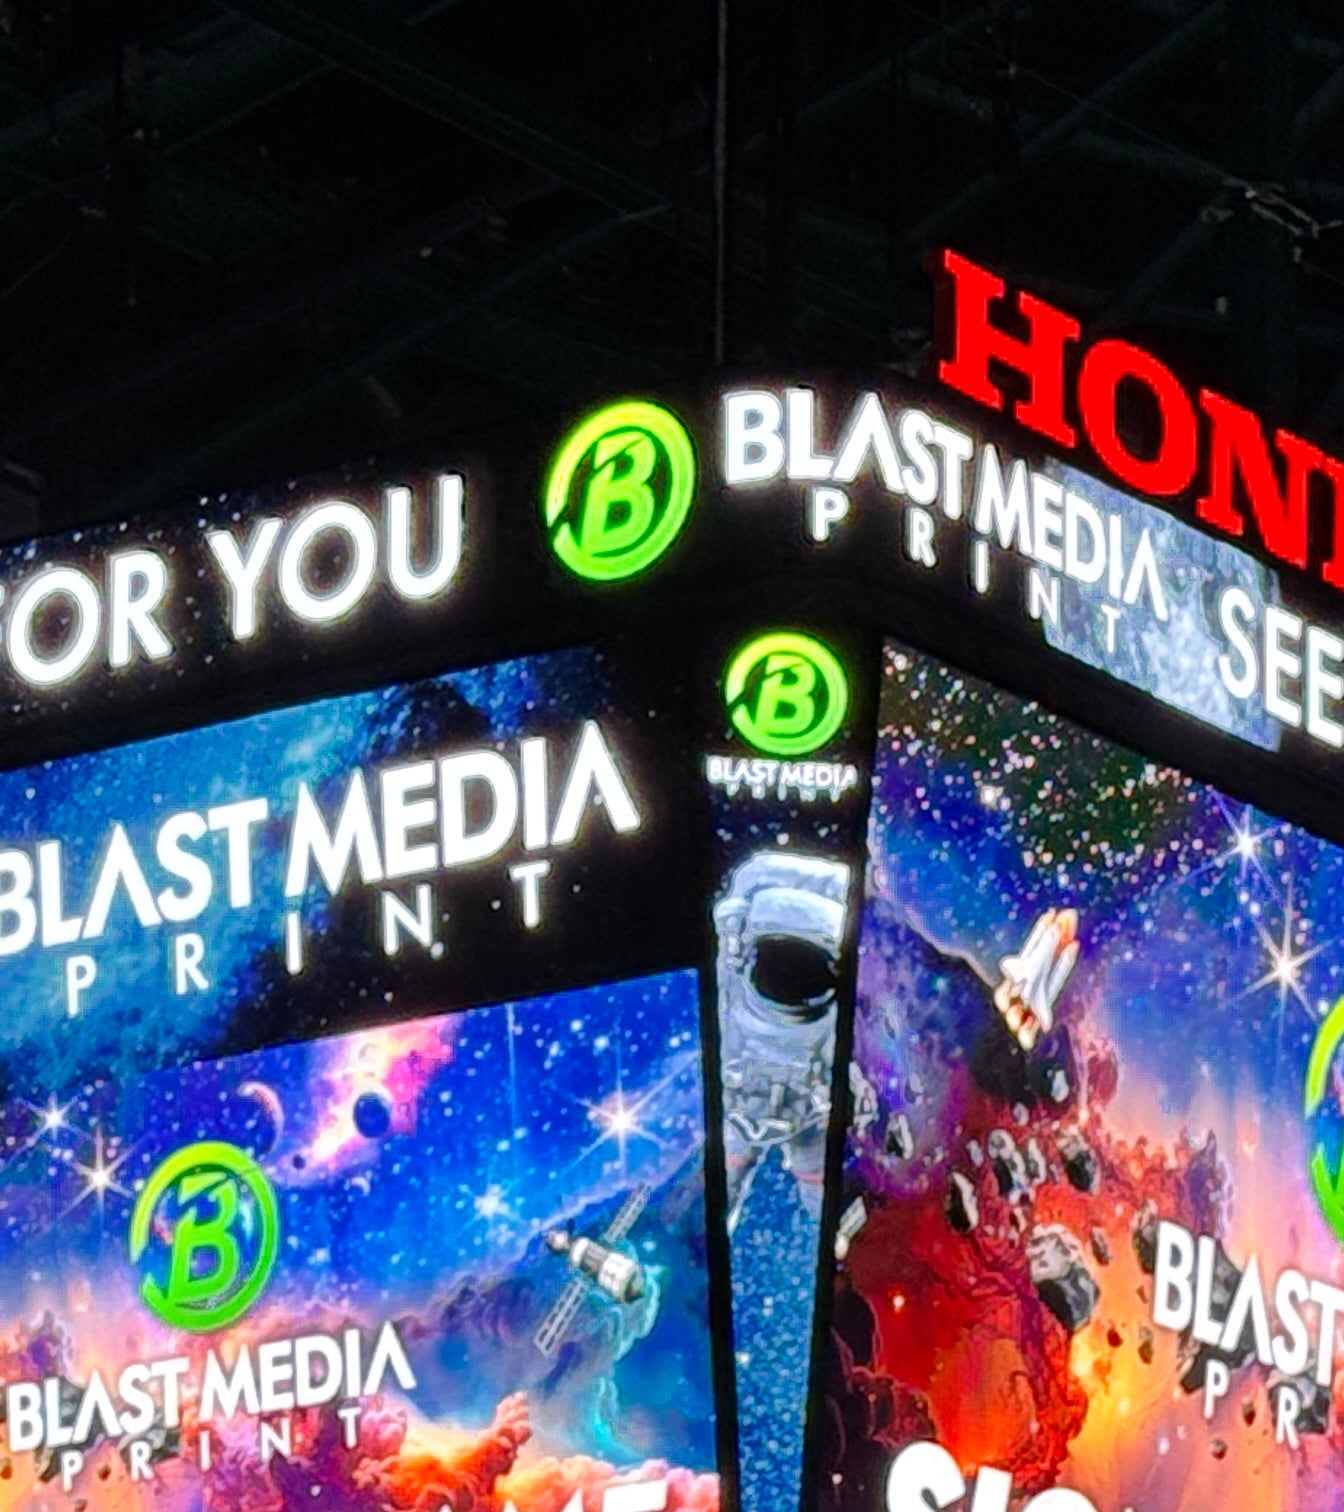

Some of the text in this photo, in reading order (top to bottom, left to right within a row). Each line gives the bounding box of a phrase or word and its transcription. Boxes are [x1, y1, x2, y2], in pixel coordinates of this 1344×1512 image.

[209, 474, 465, 638] YOU
[724, 388, 1168, 621] BLAST MEDIA
[812, 487, 1122, 653] PRINT
[286, 720, 640, 898] MEDIA
[707, 755, 858, 789] BLAST MEDIA
[67, 862, 549, 1016] PRINT
[7, 1321, 418, 1453] BLAST MEDIA
[61, 1407, 362, 1493] PRINT
